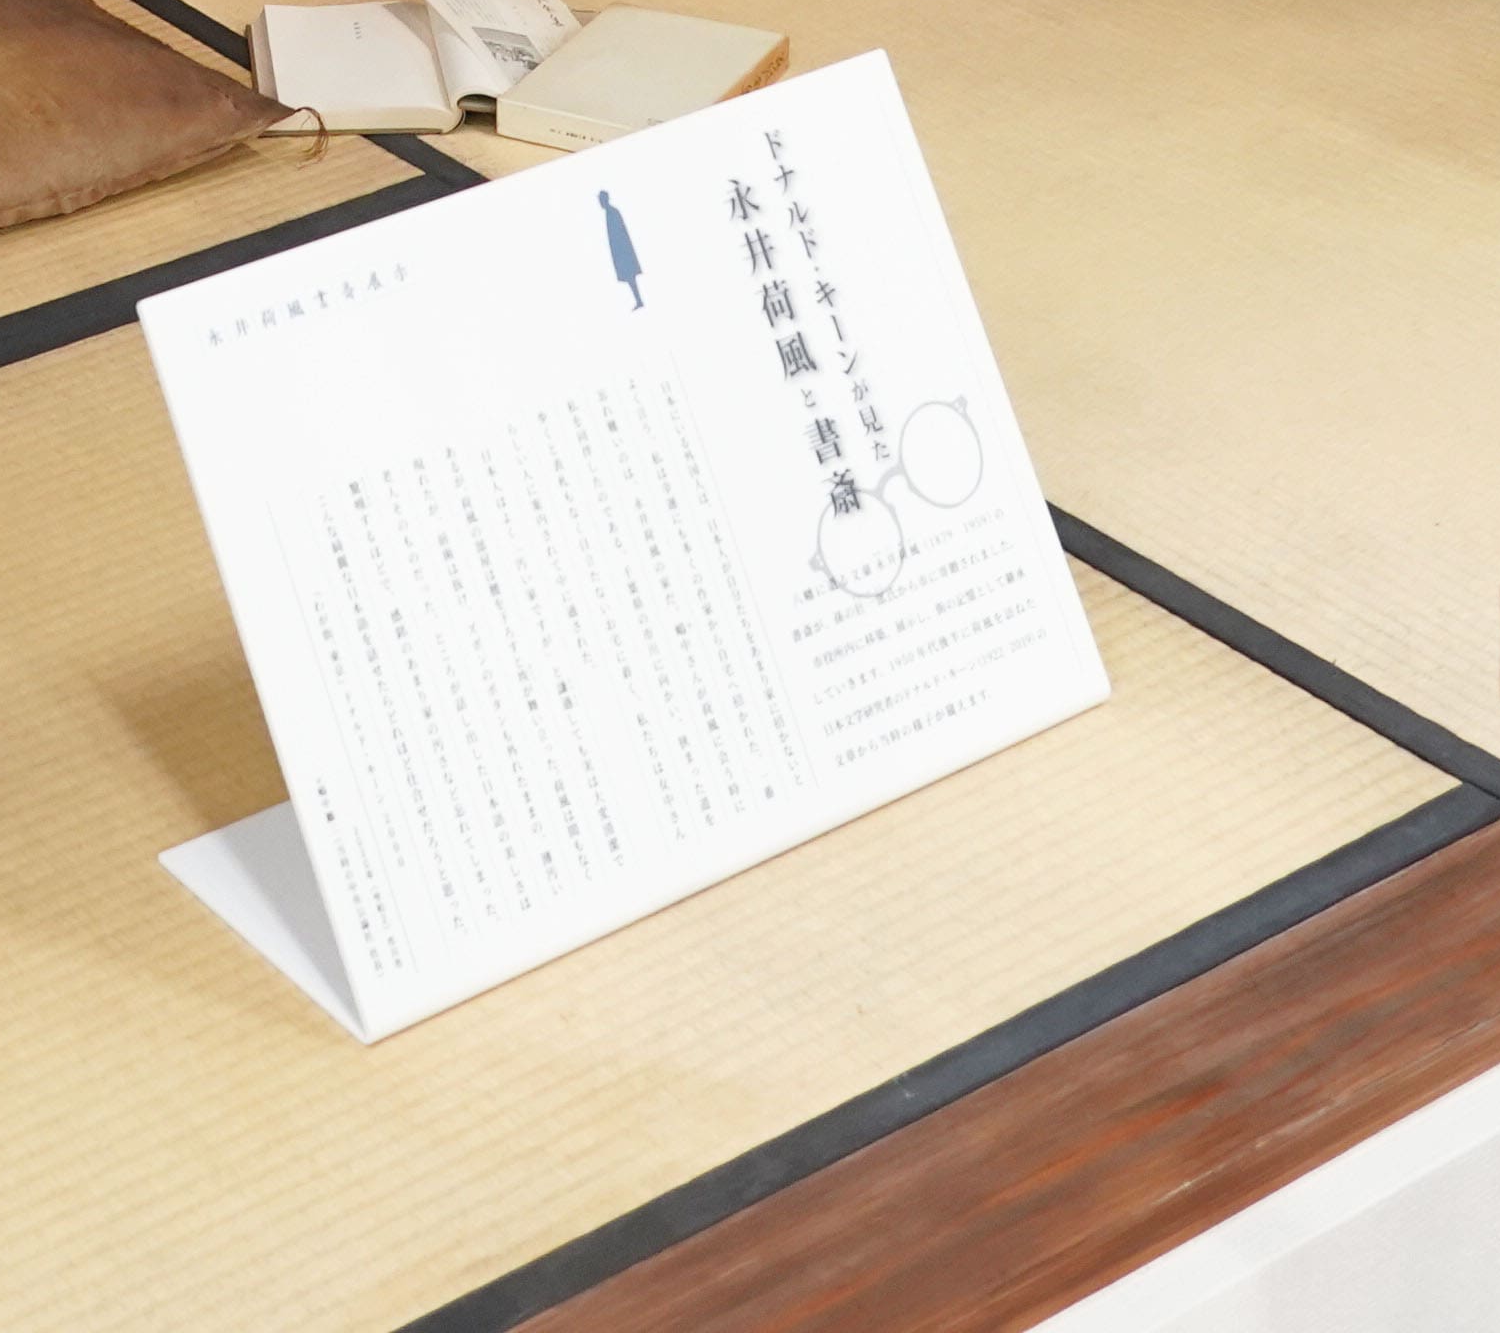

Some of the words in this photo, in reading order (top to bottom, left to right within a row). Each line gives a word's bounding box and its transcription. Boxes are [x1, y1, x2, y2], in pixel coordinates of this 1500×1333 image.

[716, 171, 866, 521] 永井荷風と書斎
[758, 127, 894, 465] ドナルド・キーンが見た
